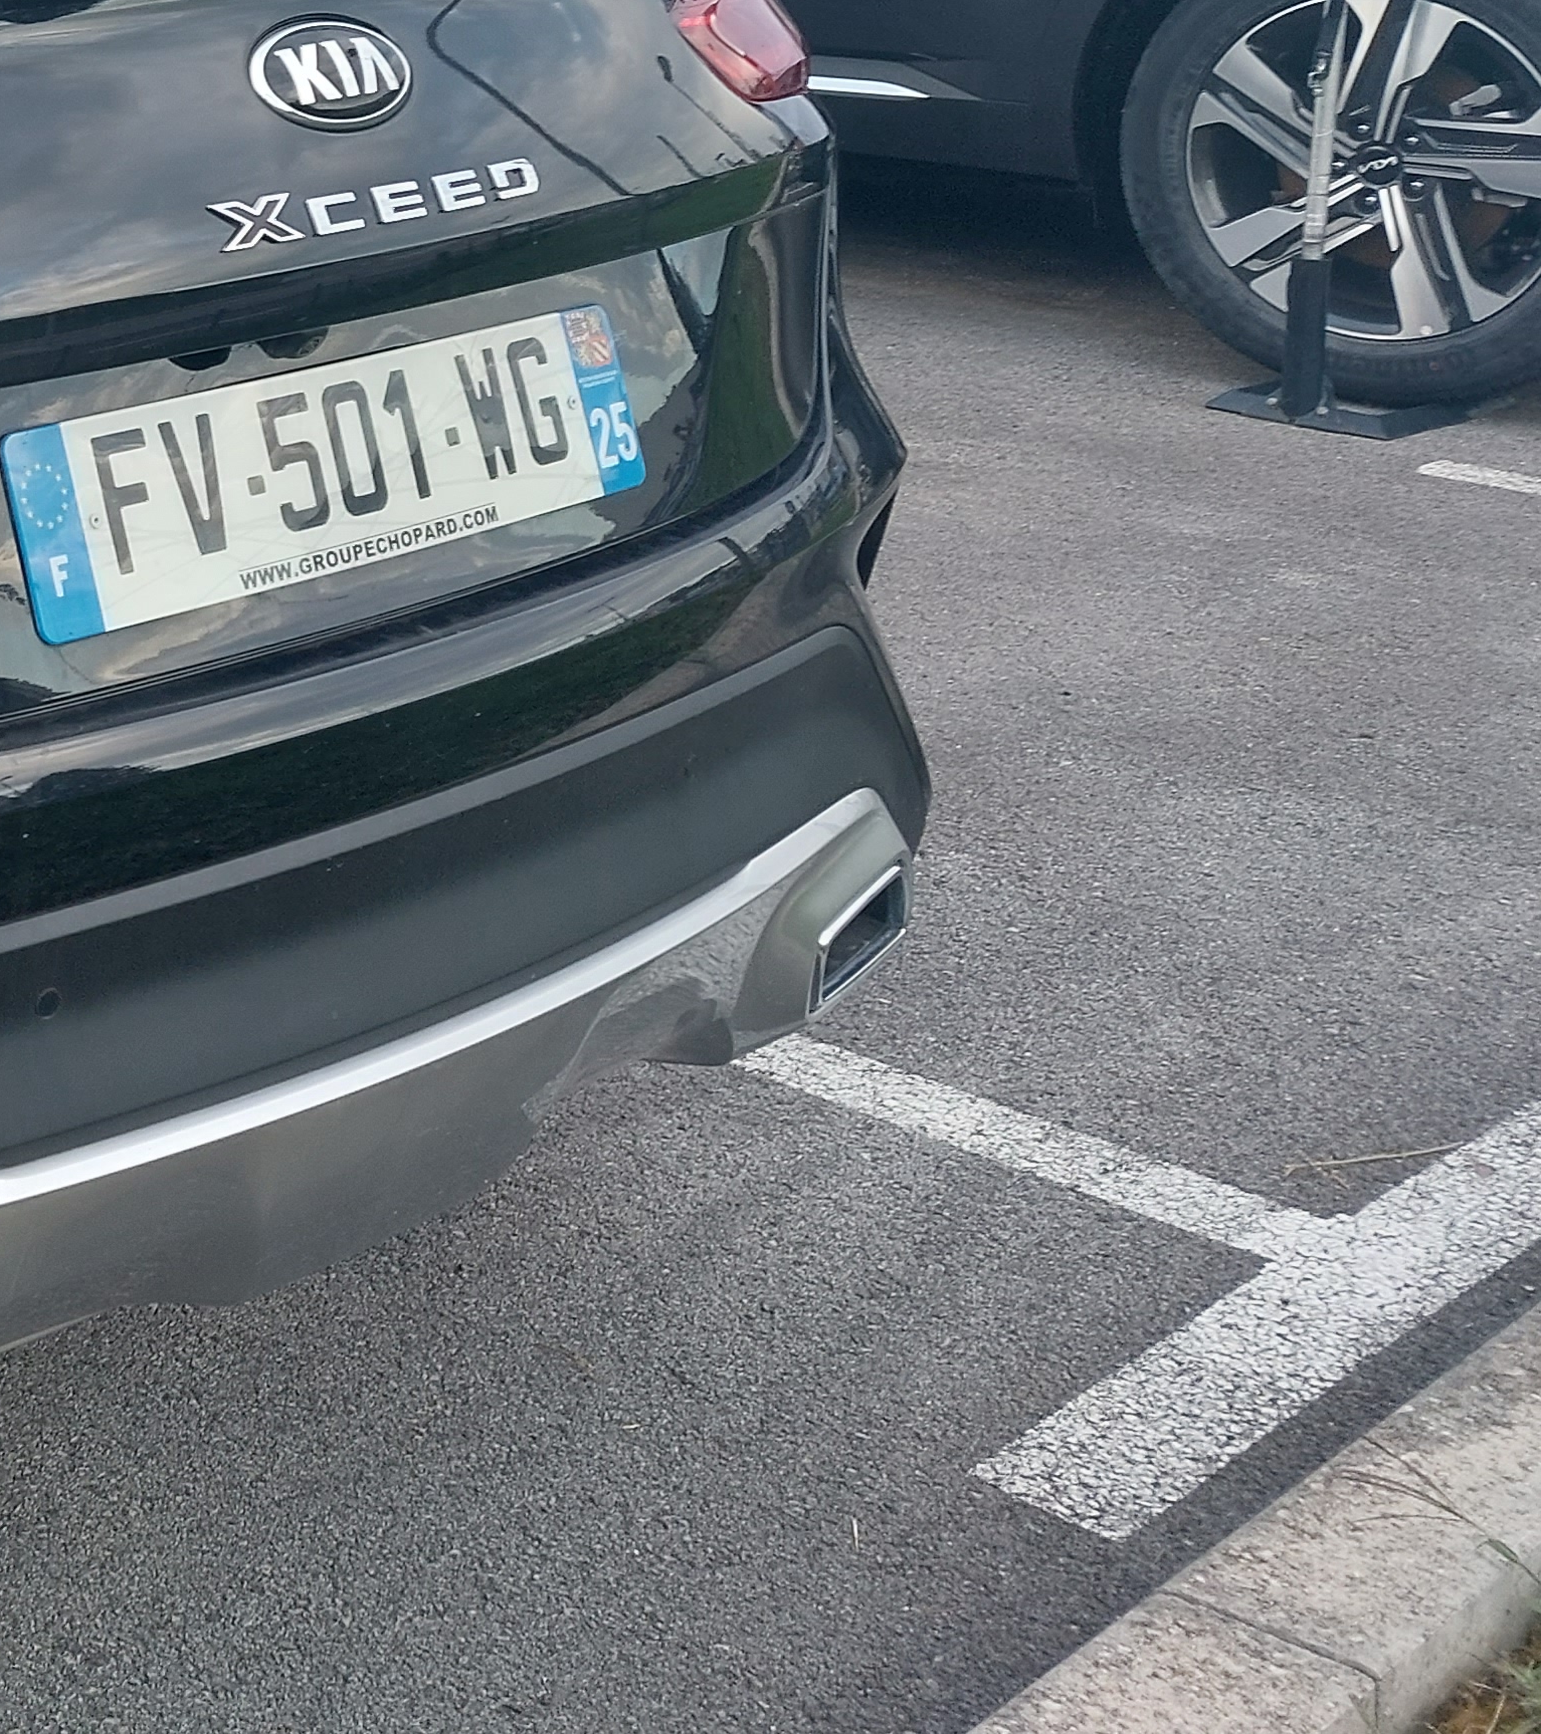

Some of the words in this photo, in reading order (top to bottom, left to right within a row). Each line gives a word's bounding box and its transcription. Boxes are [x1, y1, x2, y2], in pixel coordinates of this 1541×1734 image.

[273, 37, 400, 106] KIA
[205, 158, 541, 253] XCEED
[49, 554, 69, 598] F
[89, 336, 571, 576] FV-501-WG
[589, 401, 638, 469] 25
[239, 505, 499, 591] WWW.GROUPECHOPARD.COM
